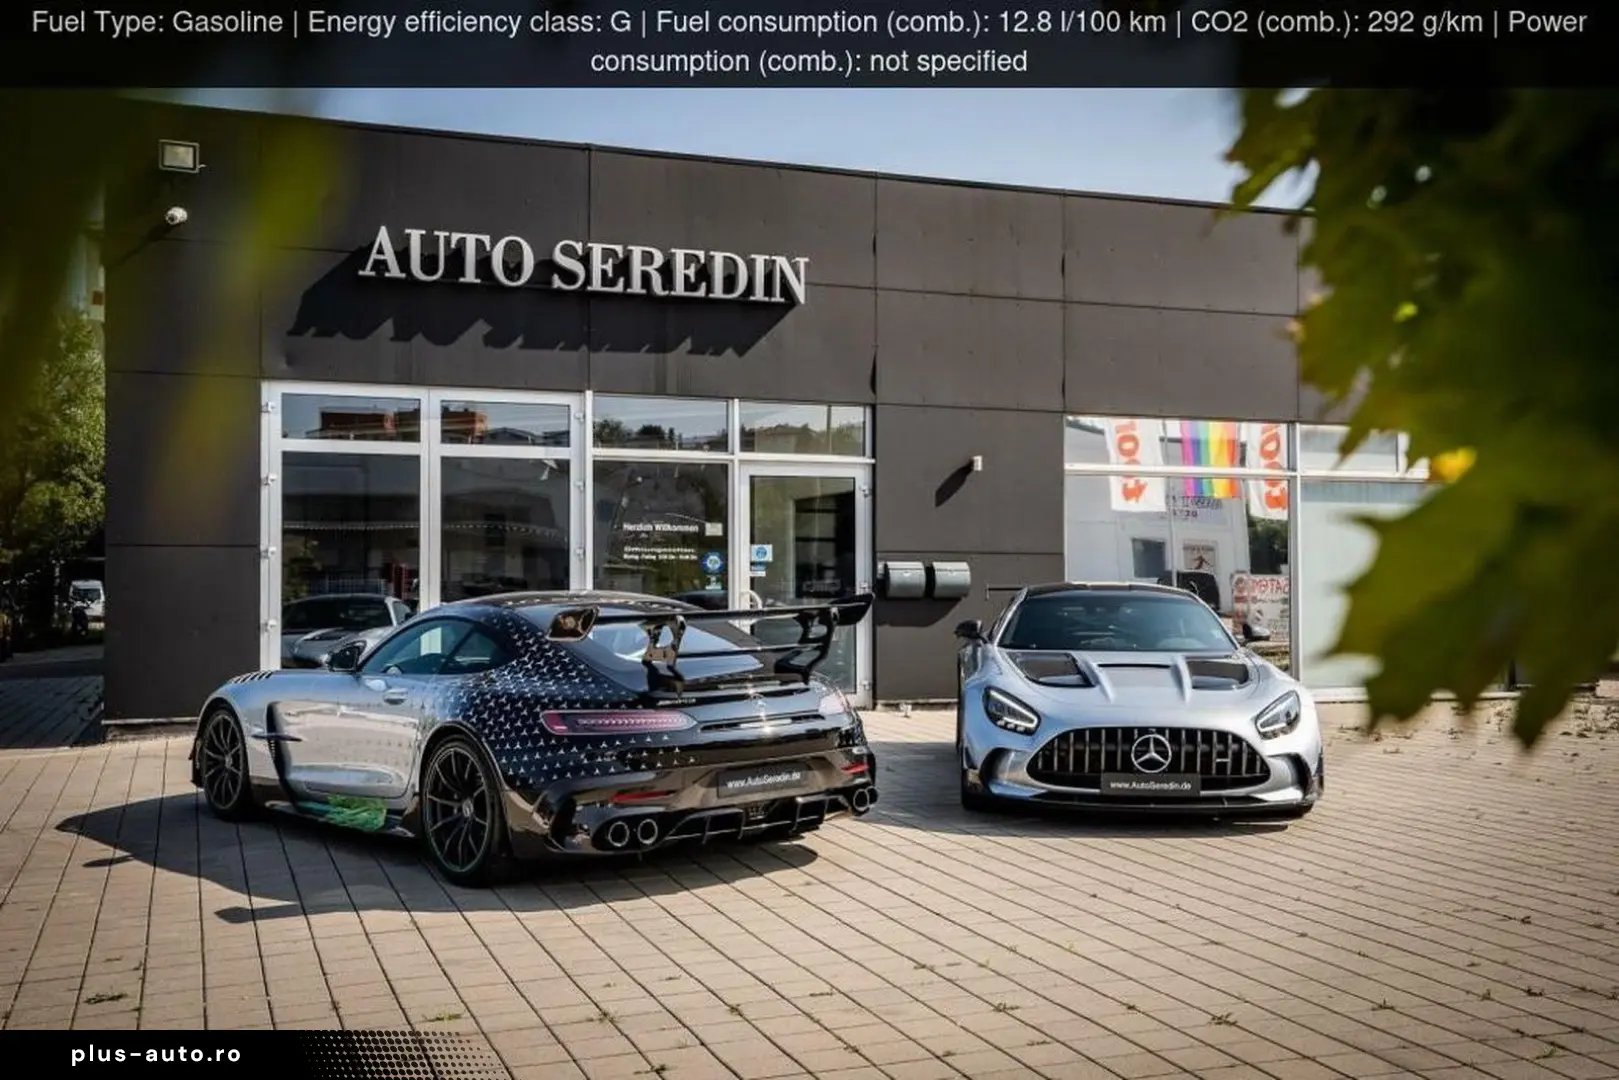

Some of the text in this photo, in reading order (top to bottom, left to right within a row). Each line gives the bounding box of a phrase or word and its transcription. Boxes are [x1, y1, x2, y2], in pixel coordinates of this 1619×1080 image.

[358, 225, 809, 304] AUTO SEREDIN
[654, 522, 699, 533] Willkommen
[726, 771, 801, 789] www.AutoSeredin.de
[1110, 780, 1191, 790] www.AutoSeredin.de
